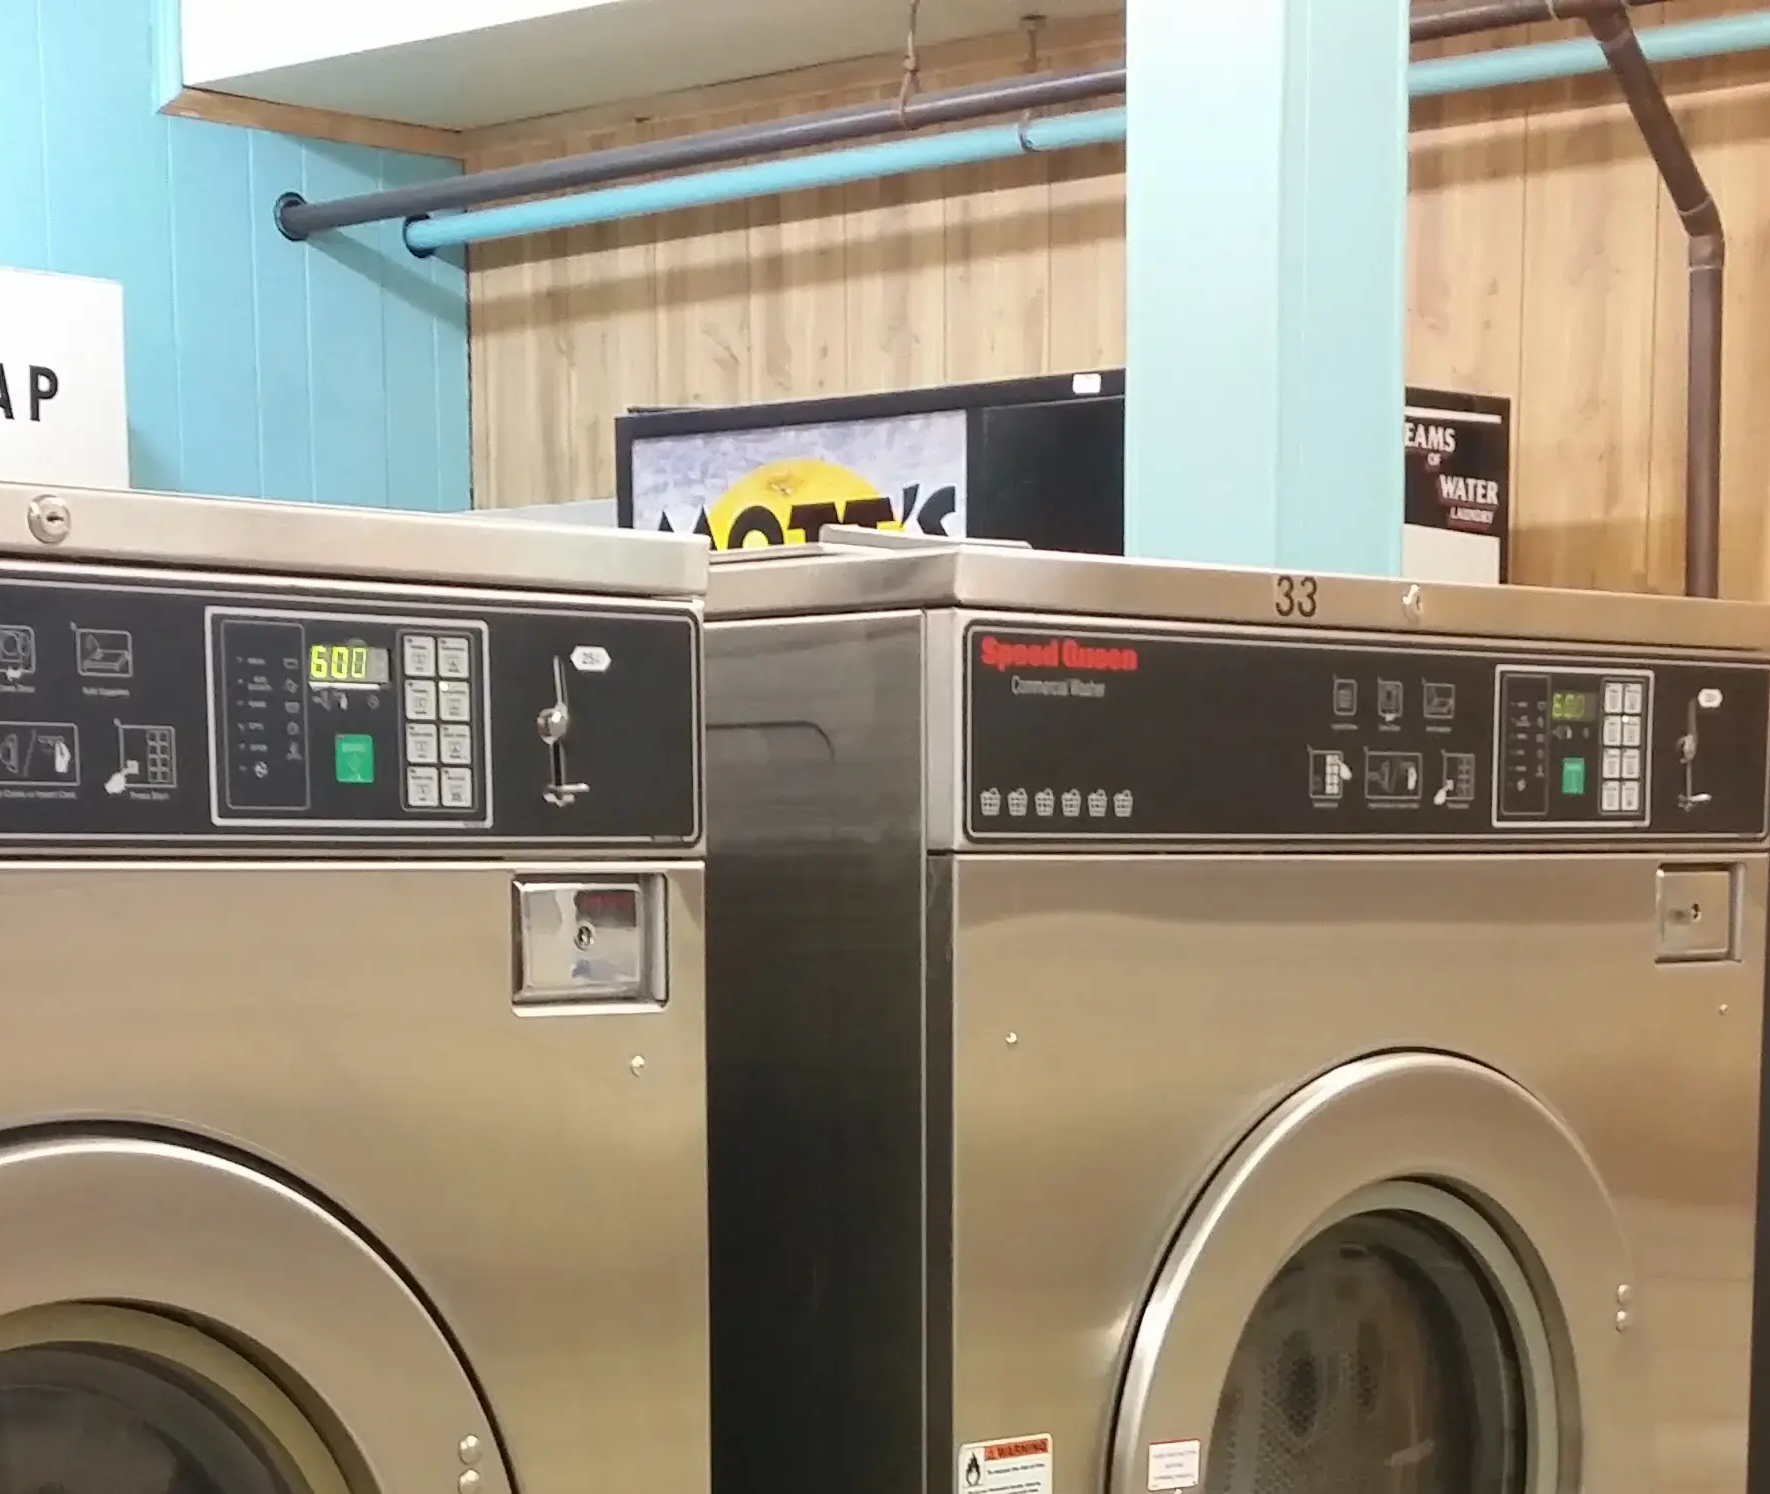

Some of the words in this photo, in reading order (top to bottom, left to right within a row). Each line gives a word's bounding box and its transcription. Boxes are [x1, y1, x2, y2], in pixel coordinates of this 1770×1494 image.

[1438, 473, 1499, 505] WATER
[1275, 574, 1318, 618] 33
[310, 645, 367, 679] 600
[981, 635, 1058, 671] Speed
[1061, 638, 1137, 671] Queen
